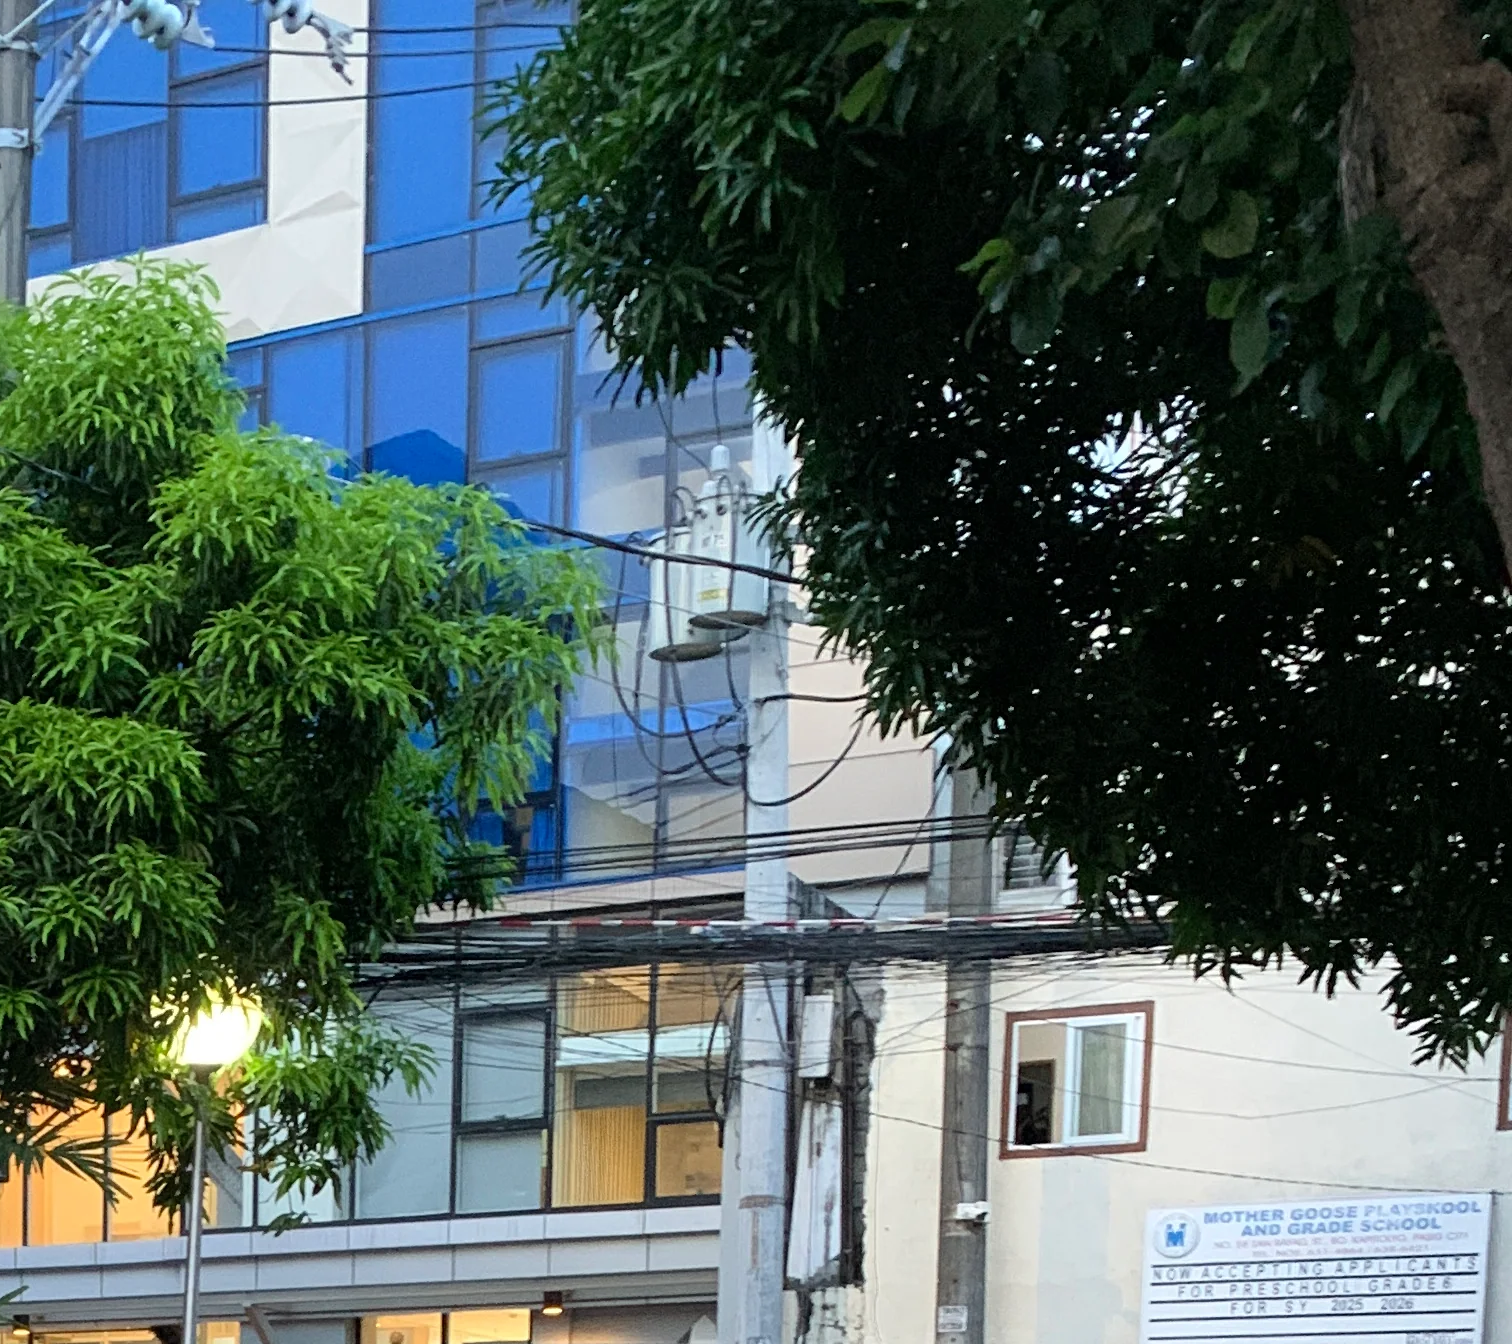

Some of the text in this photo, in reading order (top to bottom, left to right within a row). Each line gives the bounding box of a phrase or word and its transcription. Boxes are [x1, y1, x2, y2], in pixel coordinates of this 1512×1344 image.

[1204, 1201, 1481, 1224] MOTHER GOOSE PLAYSKOOL
[1241, 1217, 1441, 1236] AND GRADE SCHOOL
[1153, 1257, 1477, 1281] NOW ACCEPTING APPLICANTS
[1177, 1285, 1214, 1298] FOR
[1229, 1281, 1351, 1296] PRESCHOOL
[1230, 1298, 1414, 1314] FOR SY 2025 2026
